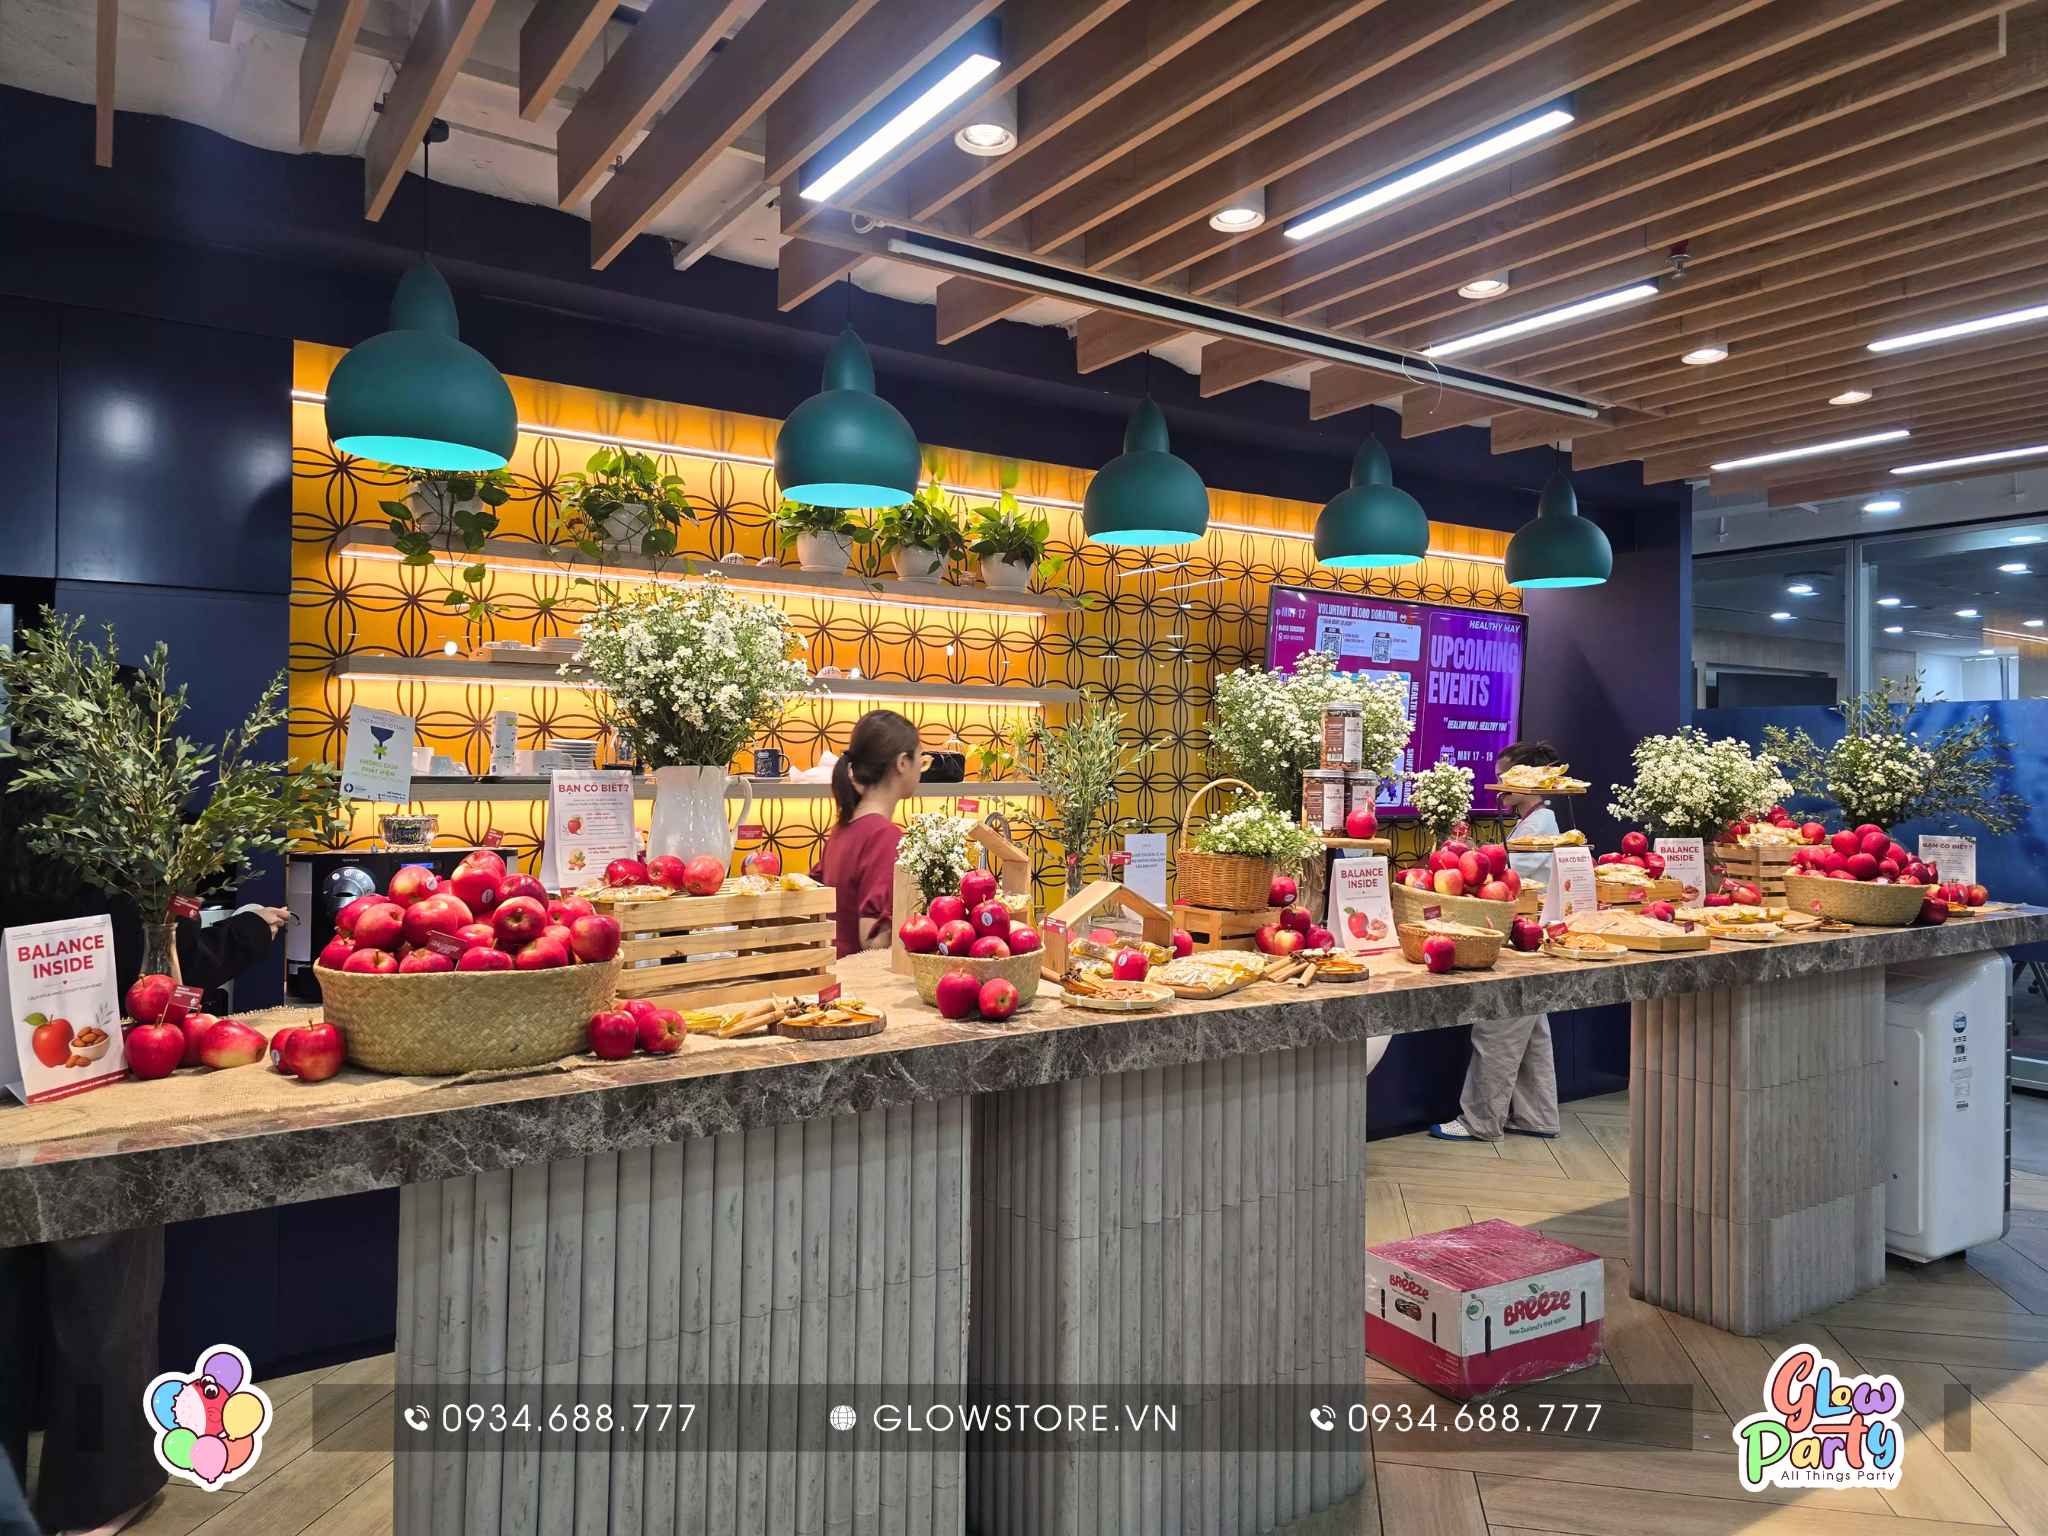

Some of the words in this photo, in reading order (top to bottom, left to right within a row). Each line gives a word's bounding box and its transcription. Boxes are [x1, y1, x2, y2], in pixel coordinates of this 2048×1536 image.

[1298, 609, 1306, 618] 17
[1318, 603, 1351, 616] VOLUNTARY
[1352, 607, 1370, 618] BLOOD
[1371, 609, 1398, 621] DONATION
[1469, 620, 1502, 631] HEALTHY
[1504, 624, 1520, 634] MAY
[1431, 635, 1519, 673] UPCOMING
[1410, 682, 1419, 710] HEALTH
[1428, 671, 1490, 706] EVENTS
[1479, 722, 1498, 731] HEALTHY
[1458, 751, 1471, 760] MAY
[1473, 751, 1480, 761] 17
[1486, 751, 1493, 761] 19
[558, 784, 581, 794] BẠN
[584, 782, 598, 792] CÓ
[601, 781, 629, 792] BIẾT?
[1341, 868, 1383, 879] BALANCE
[1348, 879, 1378, 889] INSIDE
[18, 934, 105, 962] BALANCE
[33, 955, 94, 979] INSIDE
[1520, 1323, 1542, 1333] Zealand's
[1553, 1315, 1566, 1325] apple
